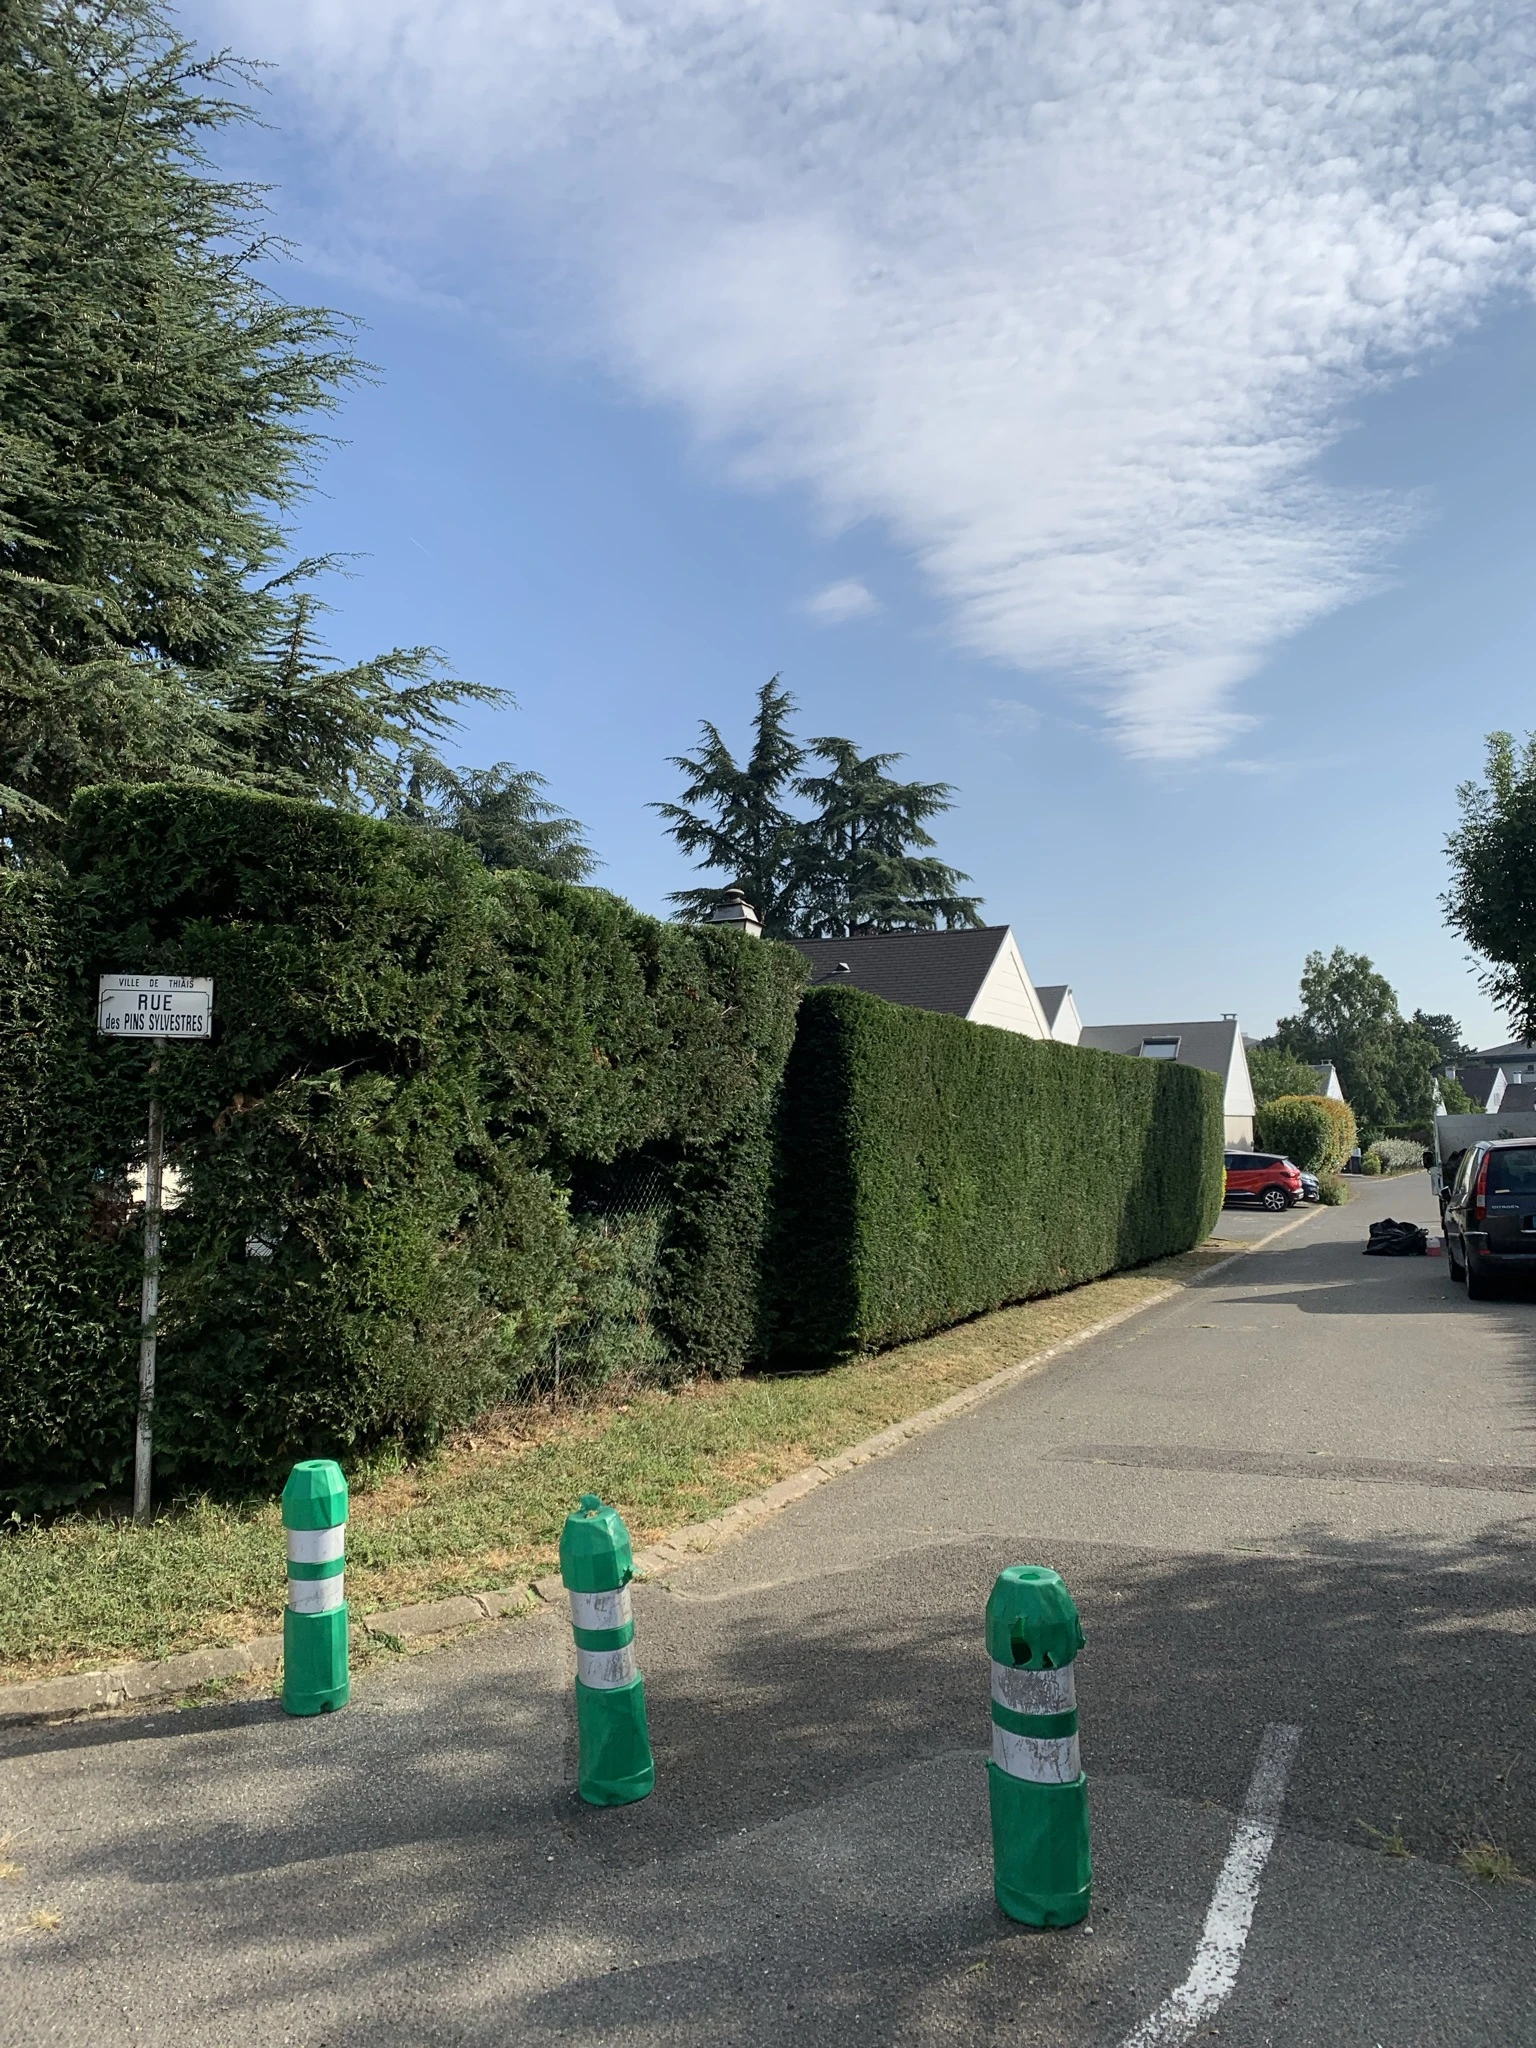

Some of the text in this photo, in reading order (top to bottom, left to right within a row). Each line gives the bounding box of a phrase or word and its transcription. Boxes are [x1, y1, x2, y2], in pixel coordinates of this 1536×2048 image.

[118, 978, 194, 988] VILLE DE THIAIS
[137, 993, 173, 1012] RUE
[105, 1012, 203, 1032] des PINS SYLVESTRES
